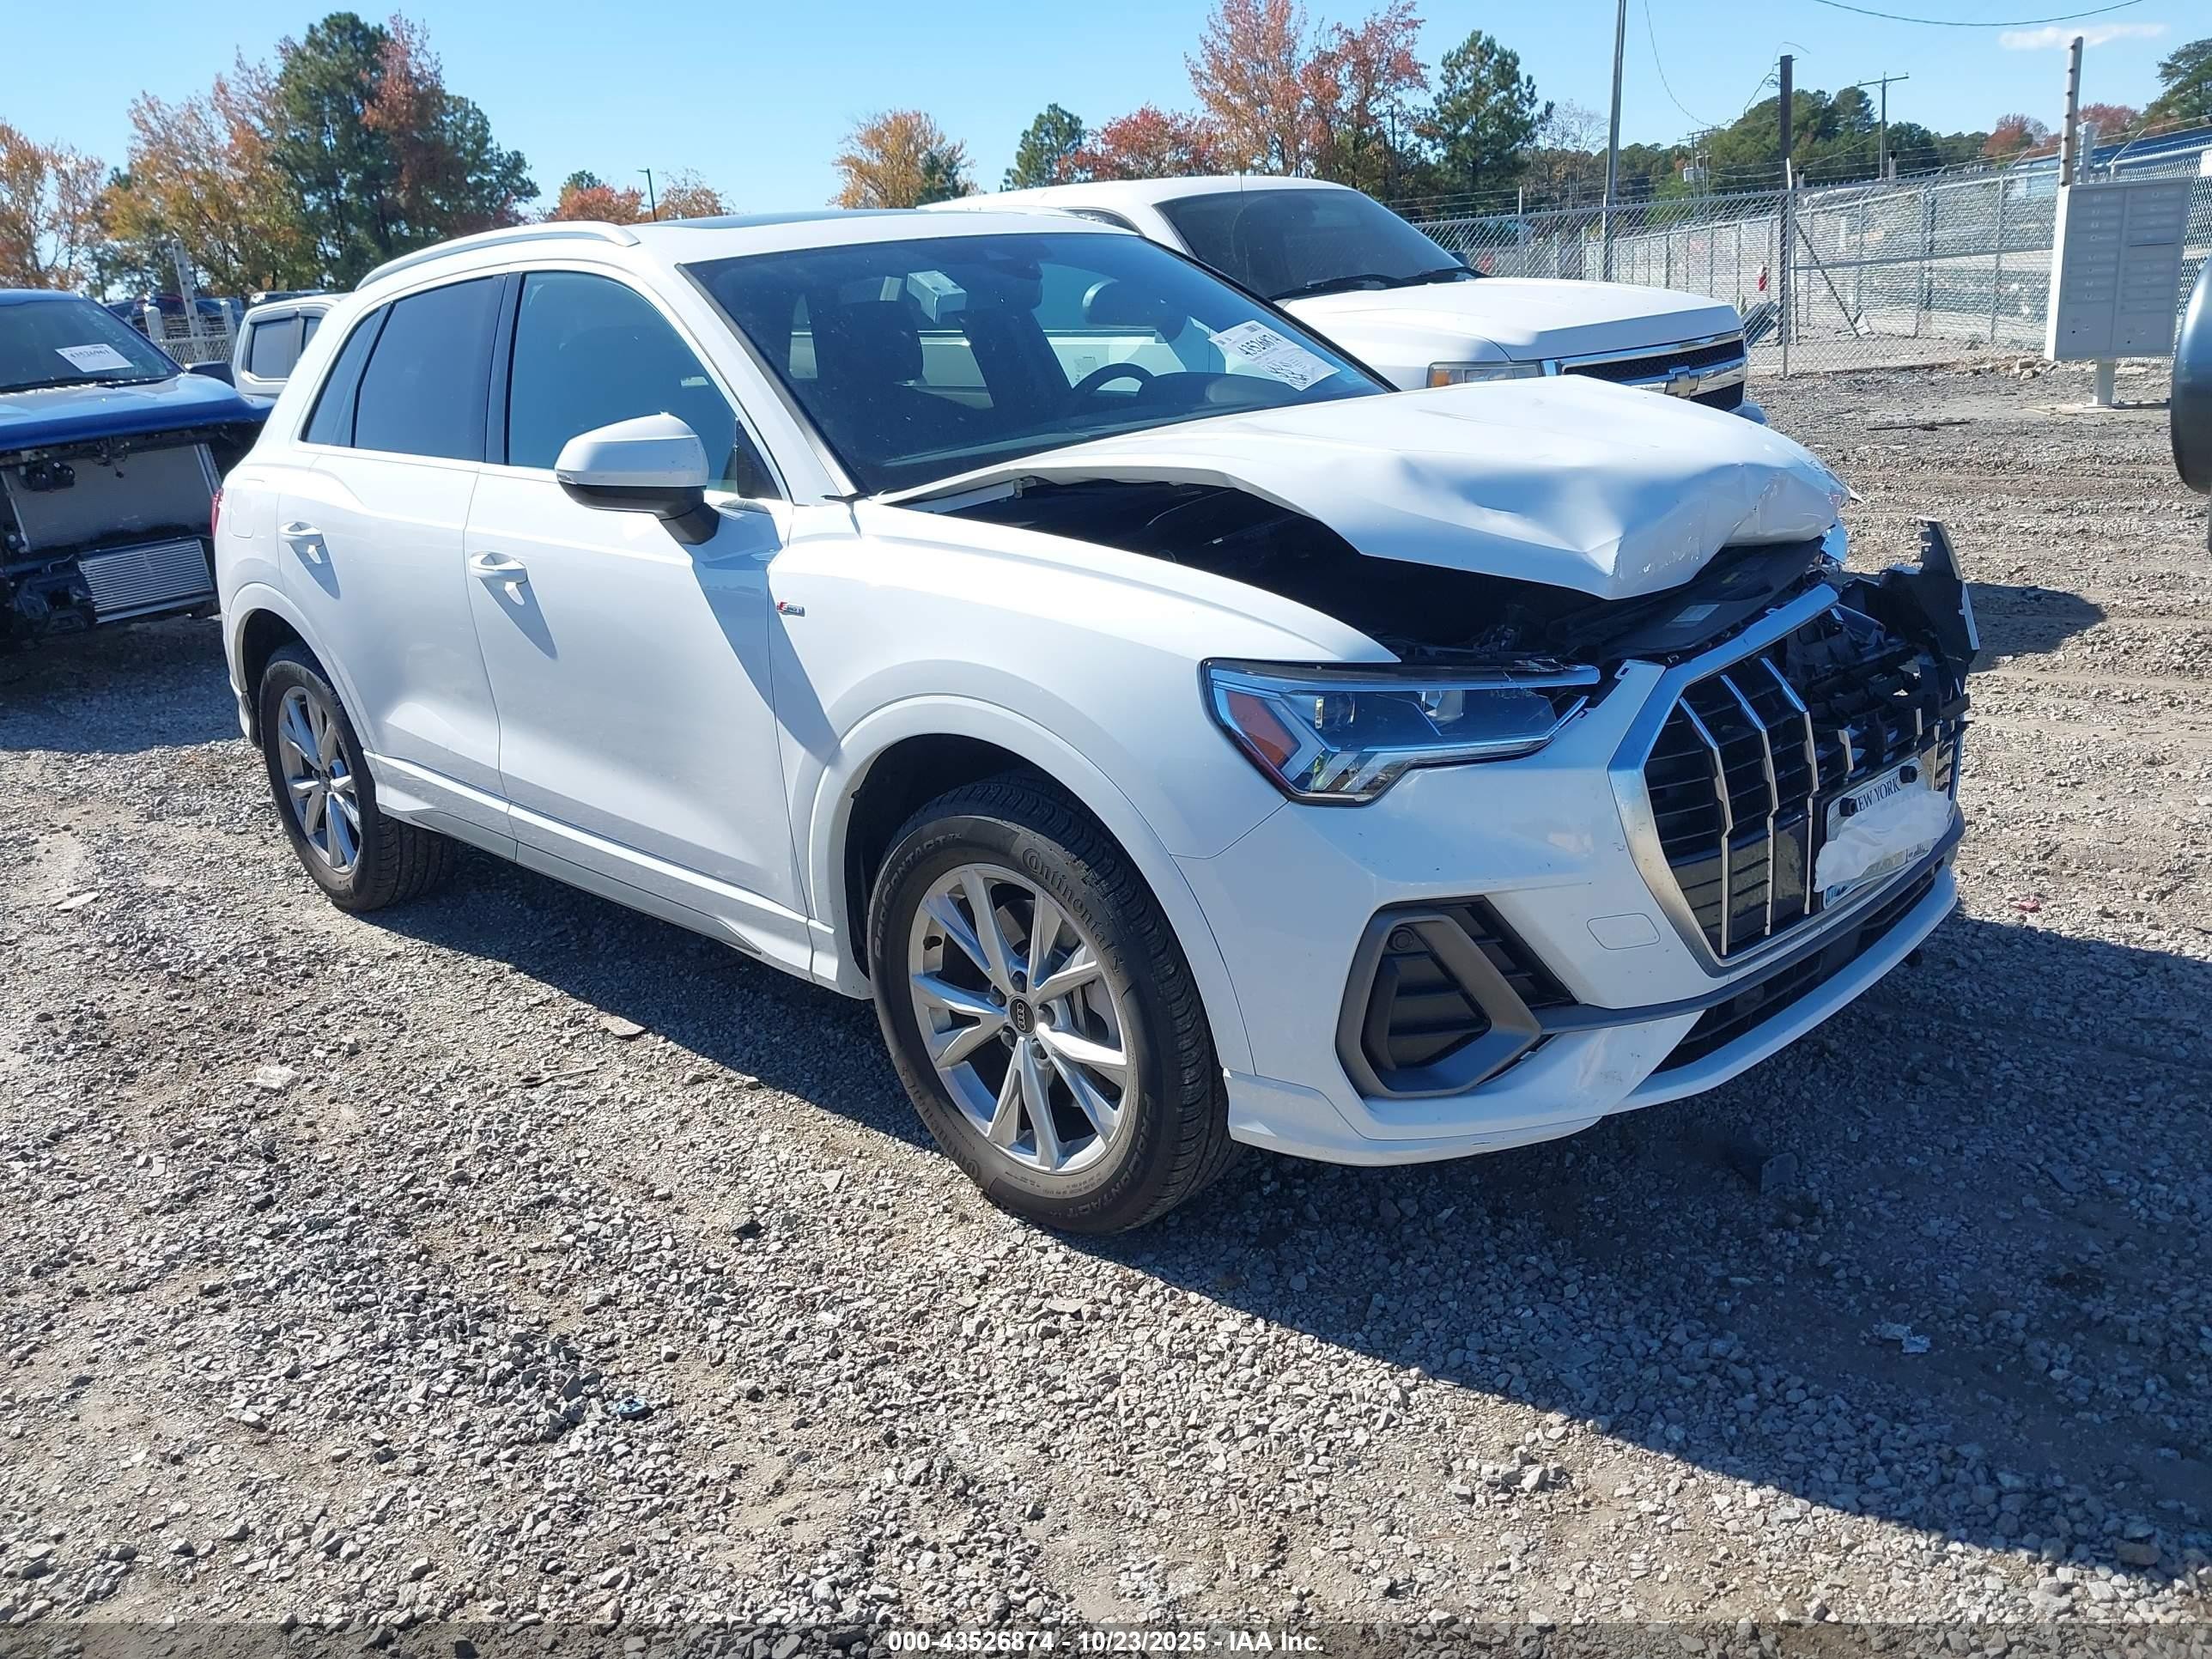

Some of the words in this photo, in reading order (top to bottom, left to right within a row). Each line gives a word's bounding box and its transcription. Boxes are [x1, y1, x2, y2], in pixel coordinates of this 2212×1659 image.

[1237, 333, 1283, 356] 43526874
[1876, 777, 1900, 801] YORK
[1022, 848, 1119, 956] Continental
